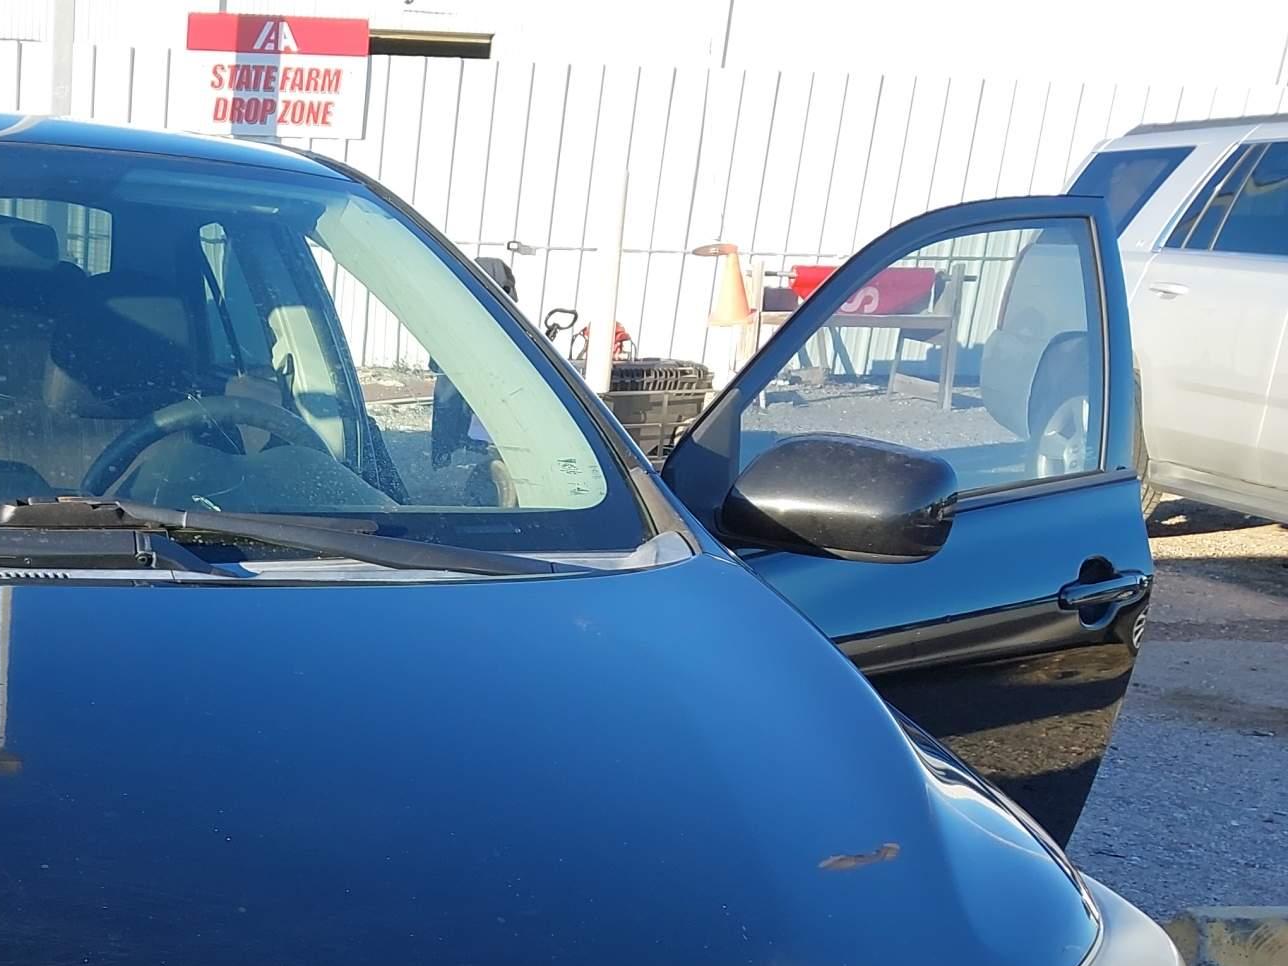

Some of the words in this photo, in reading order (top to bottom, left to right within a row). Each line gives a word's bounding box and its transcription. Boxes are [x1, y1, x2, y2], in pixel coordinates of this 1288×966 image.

[210, 64, 278, 93] STATE
[279, 66, 343, 95] FARM
[213, 97, 277, 125] DROP
[277, 100, 335, 127] ZONE
